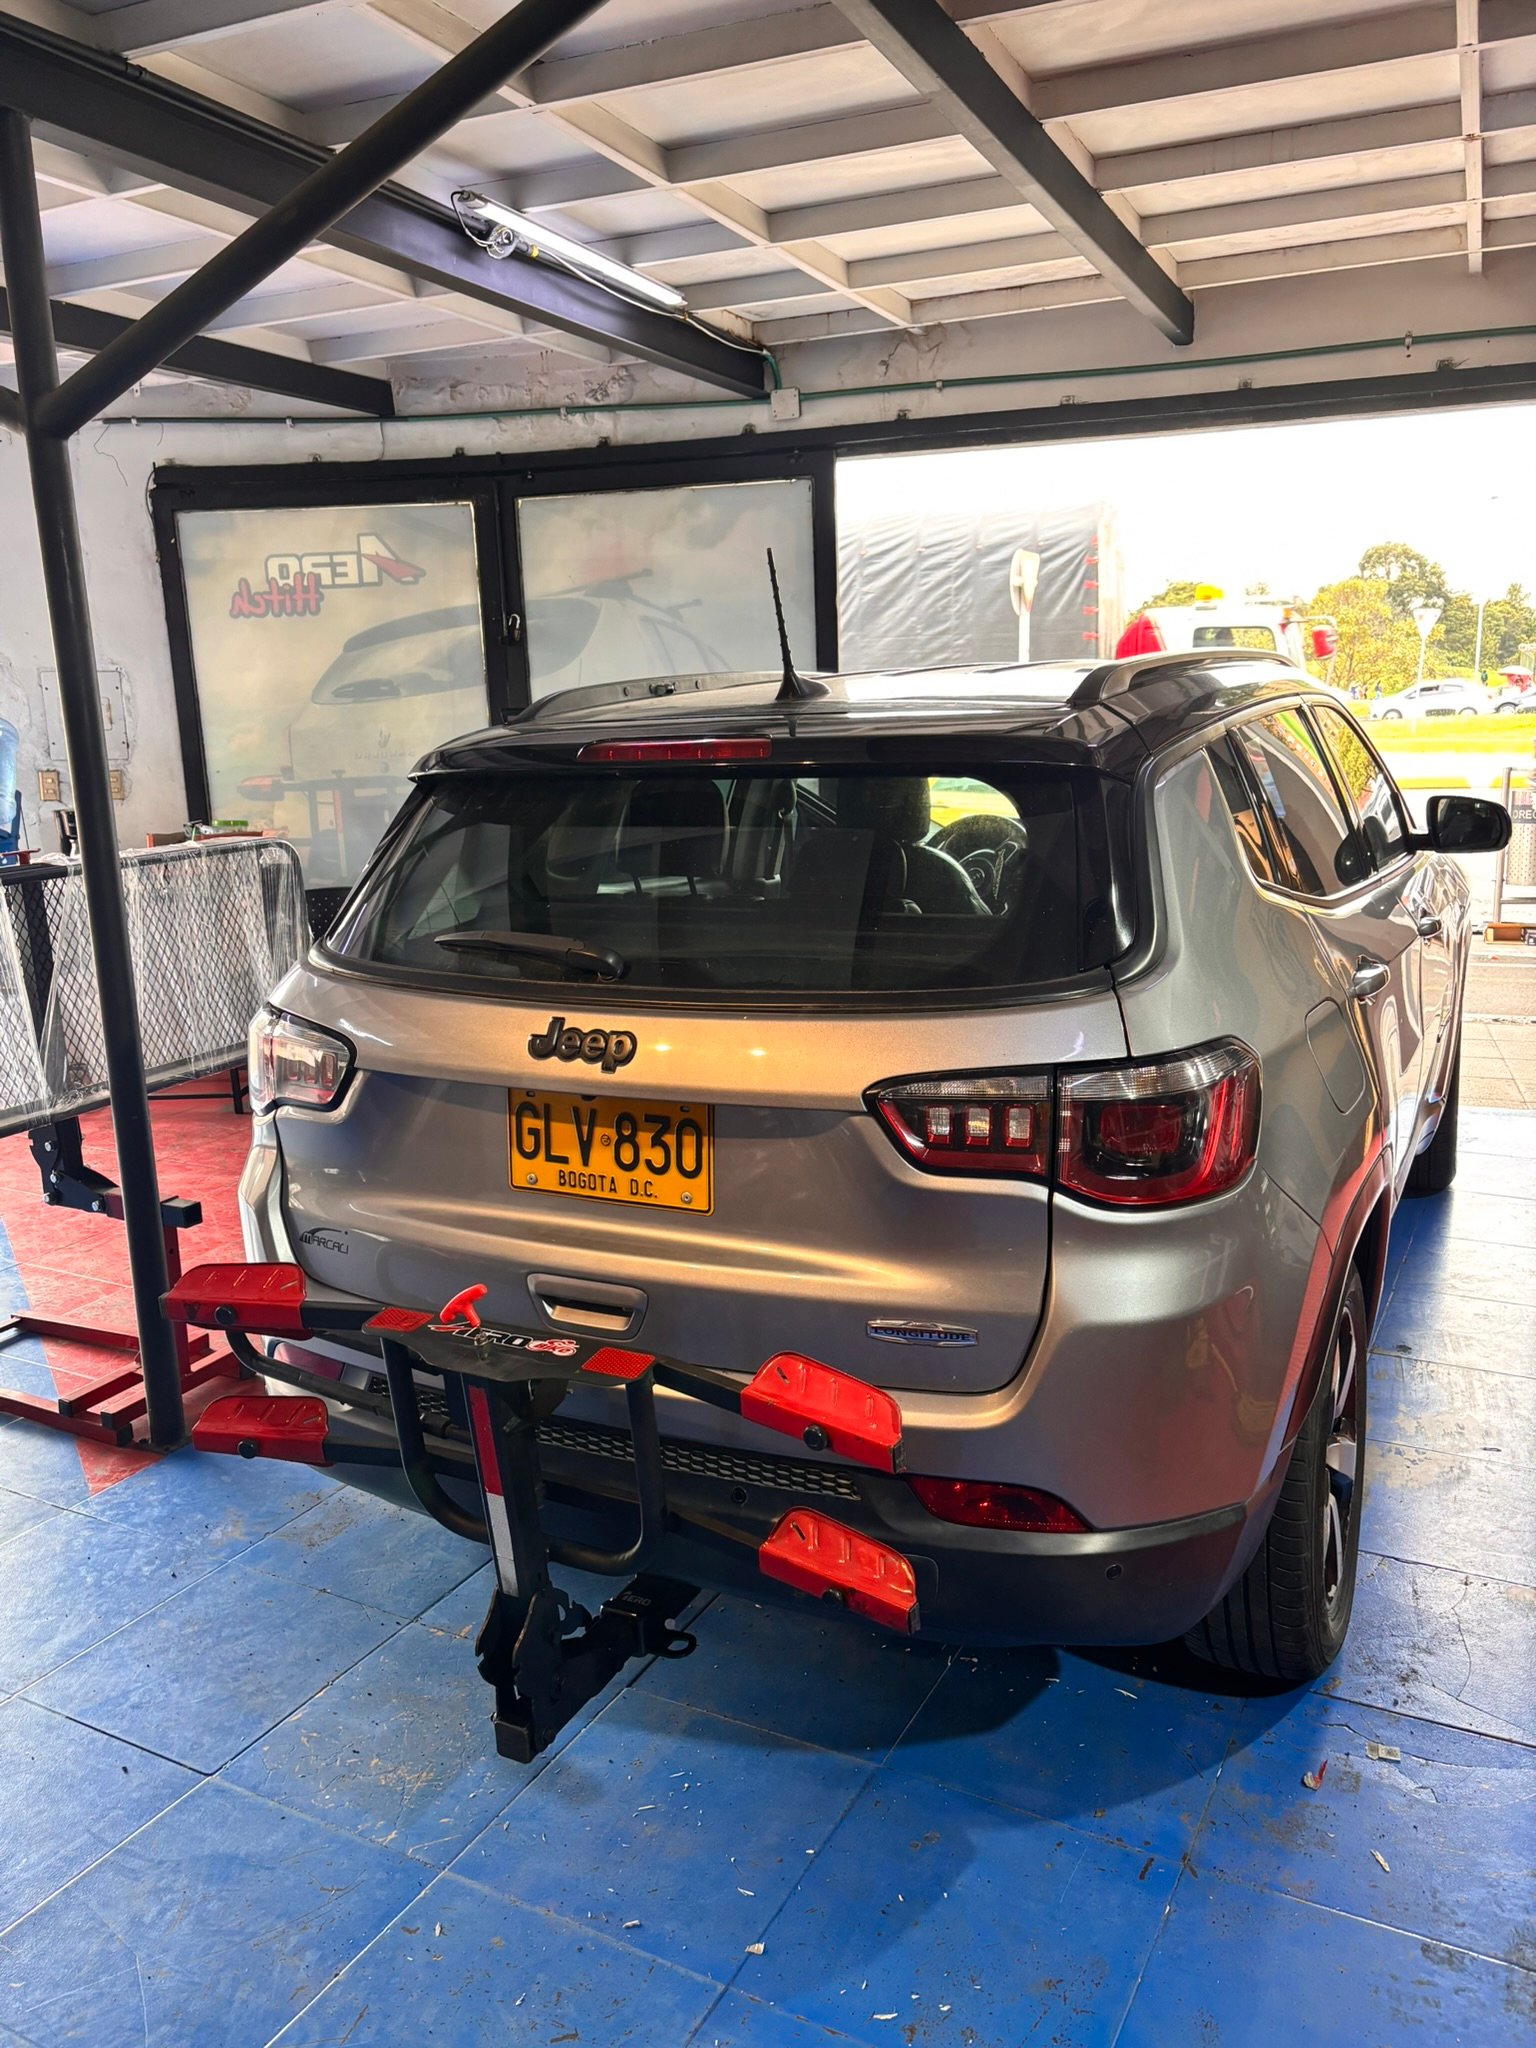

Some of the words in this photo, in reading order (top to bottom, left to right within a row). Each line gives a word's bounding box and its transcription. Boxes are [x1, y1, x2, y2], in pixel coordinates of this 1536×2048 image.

[528, 1016, 637, 1074] Jeep
[515, 1101, 597, 1167] GLV
[614, 1111, 703, 1179] 830
[558, 1169, 617, 1193] BOGOTA
[630, 1179, 658, 1199] D.C.
[873, 1328, 972, 1341] LONGITUDE
